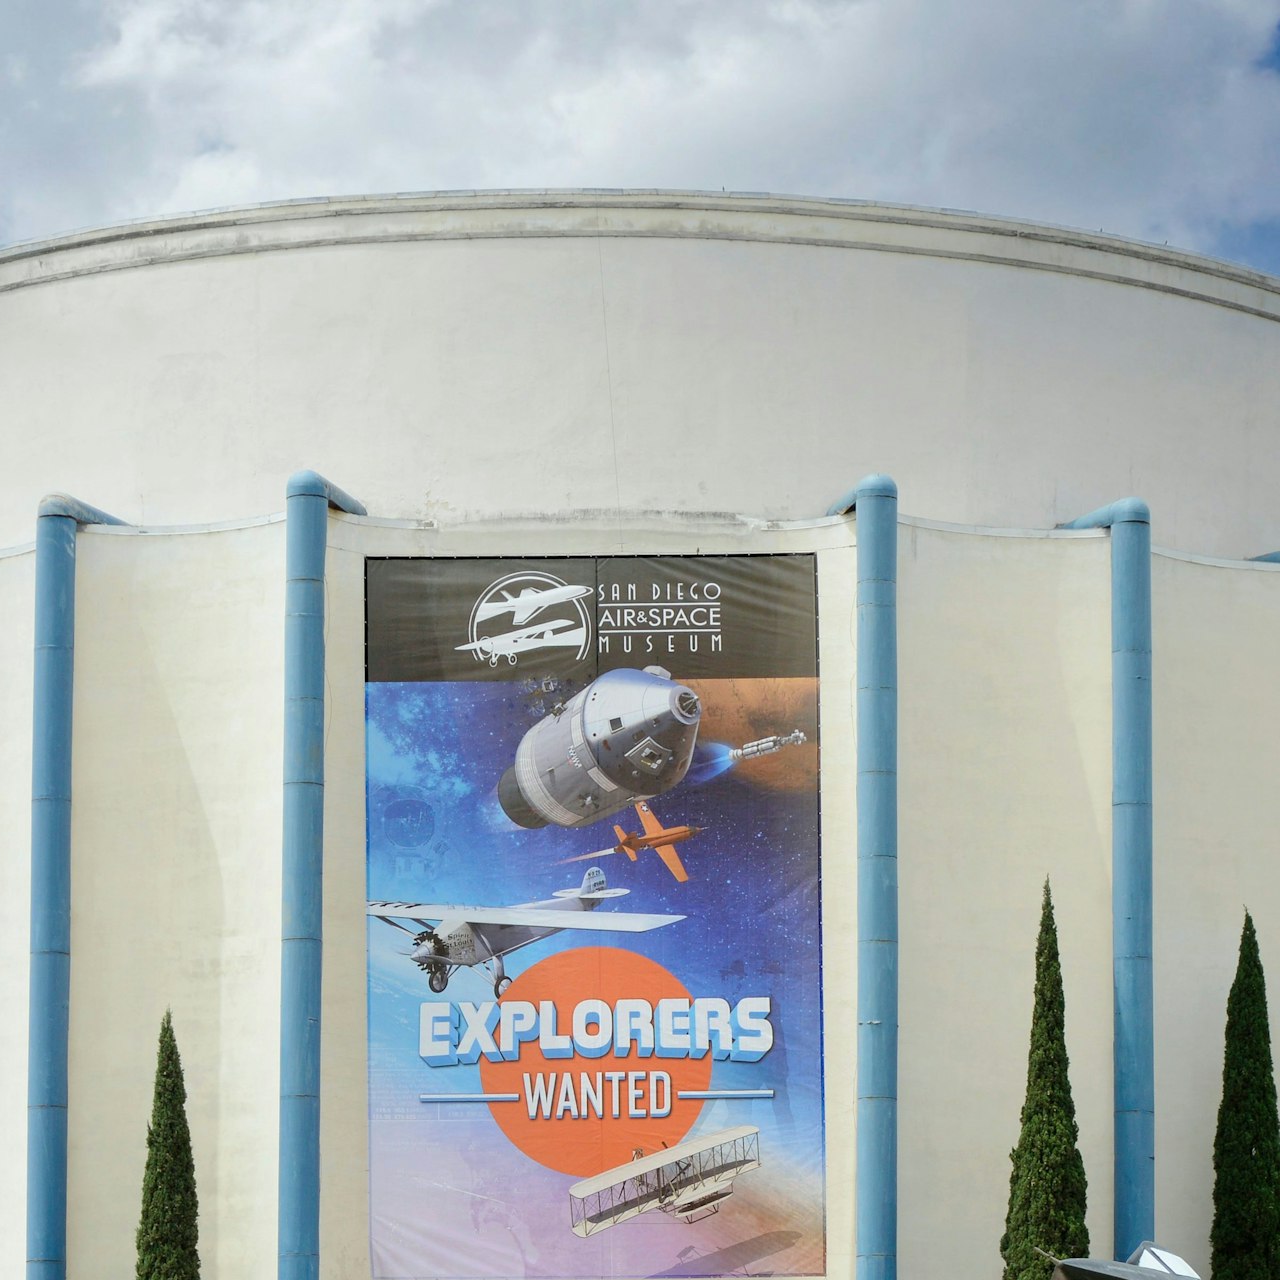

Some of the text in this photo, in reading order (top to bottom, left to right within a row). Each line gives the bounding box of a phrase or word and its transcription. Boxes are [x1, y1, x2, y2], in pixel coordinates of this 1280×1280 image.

[598, 582, 721, 601] SAN DIEGO
[598, 607, 721, 627] AIR&SPACE
[599, 634, 722, 653] MUSEUM
[419, 997, 773, 1067] EXPLORERS
[523, 1071, 671, 1120] WANTED
